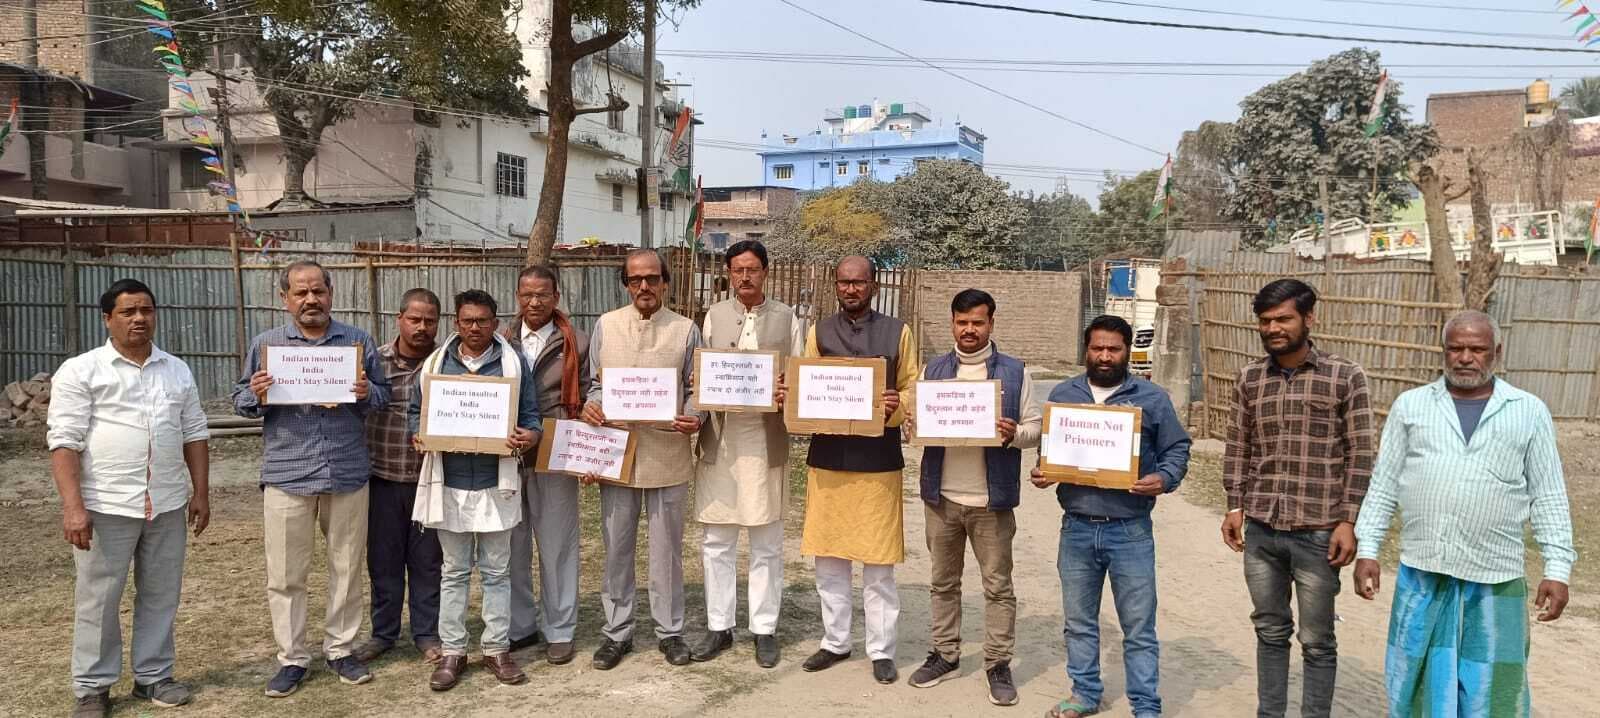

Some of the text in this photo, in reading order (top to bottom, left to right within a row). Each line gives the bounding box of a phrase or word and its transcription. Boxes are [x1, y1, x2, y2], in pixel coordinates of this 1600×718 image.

[303, 378, 321, 386] Stay
[811, 373, 862, 382] Indian insulted
[442, 388, 498, 398] Indian insulted
[460, 400, 479, 408] India
[828, 395, 842, 404] Stay
[844, 395, 865, 403] Silent
[437, 410, 500, 420] Don't Stay Silent
[1059, 417, 1123, 432] Human Not
[1064, 433, 1116, 447] Prisoners
